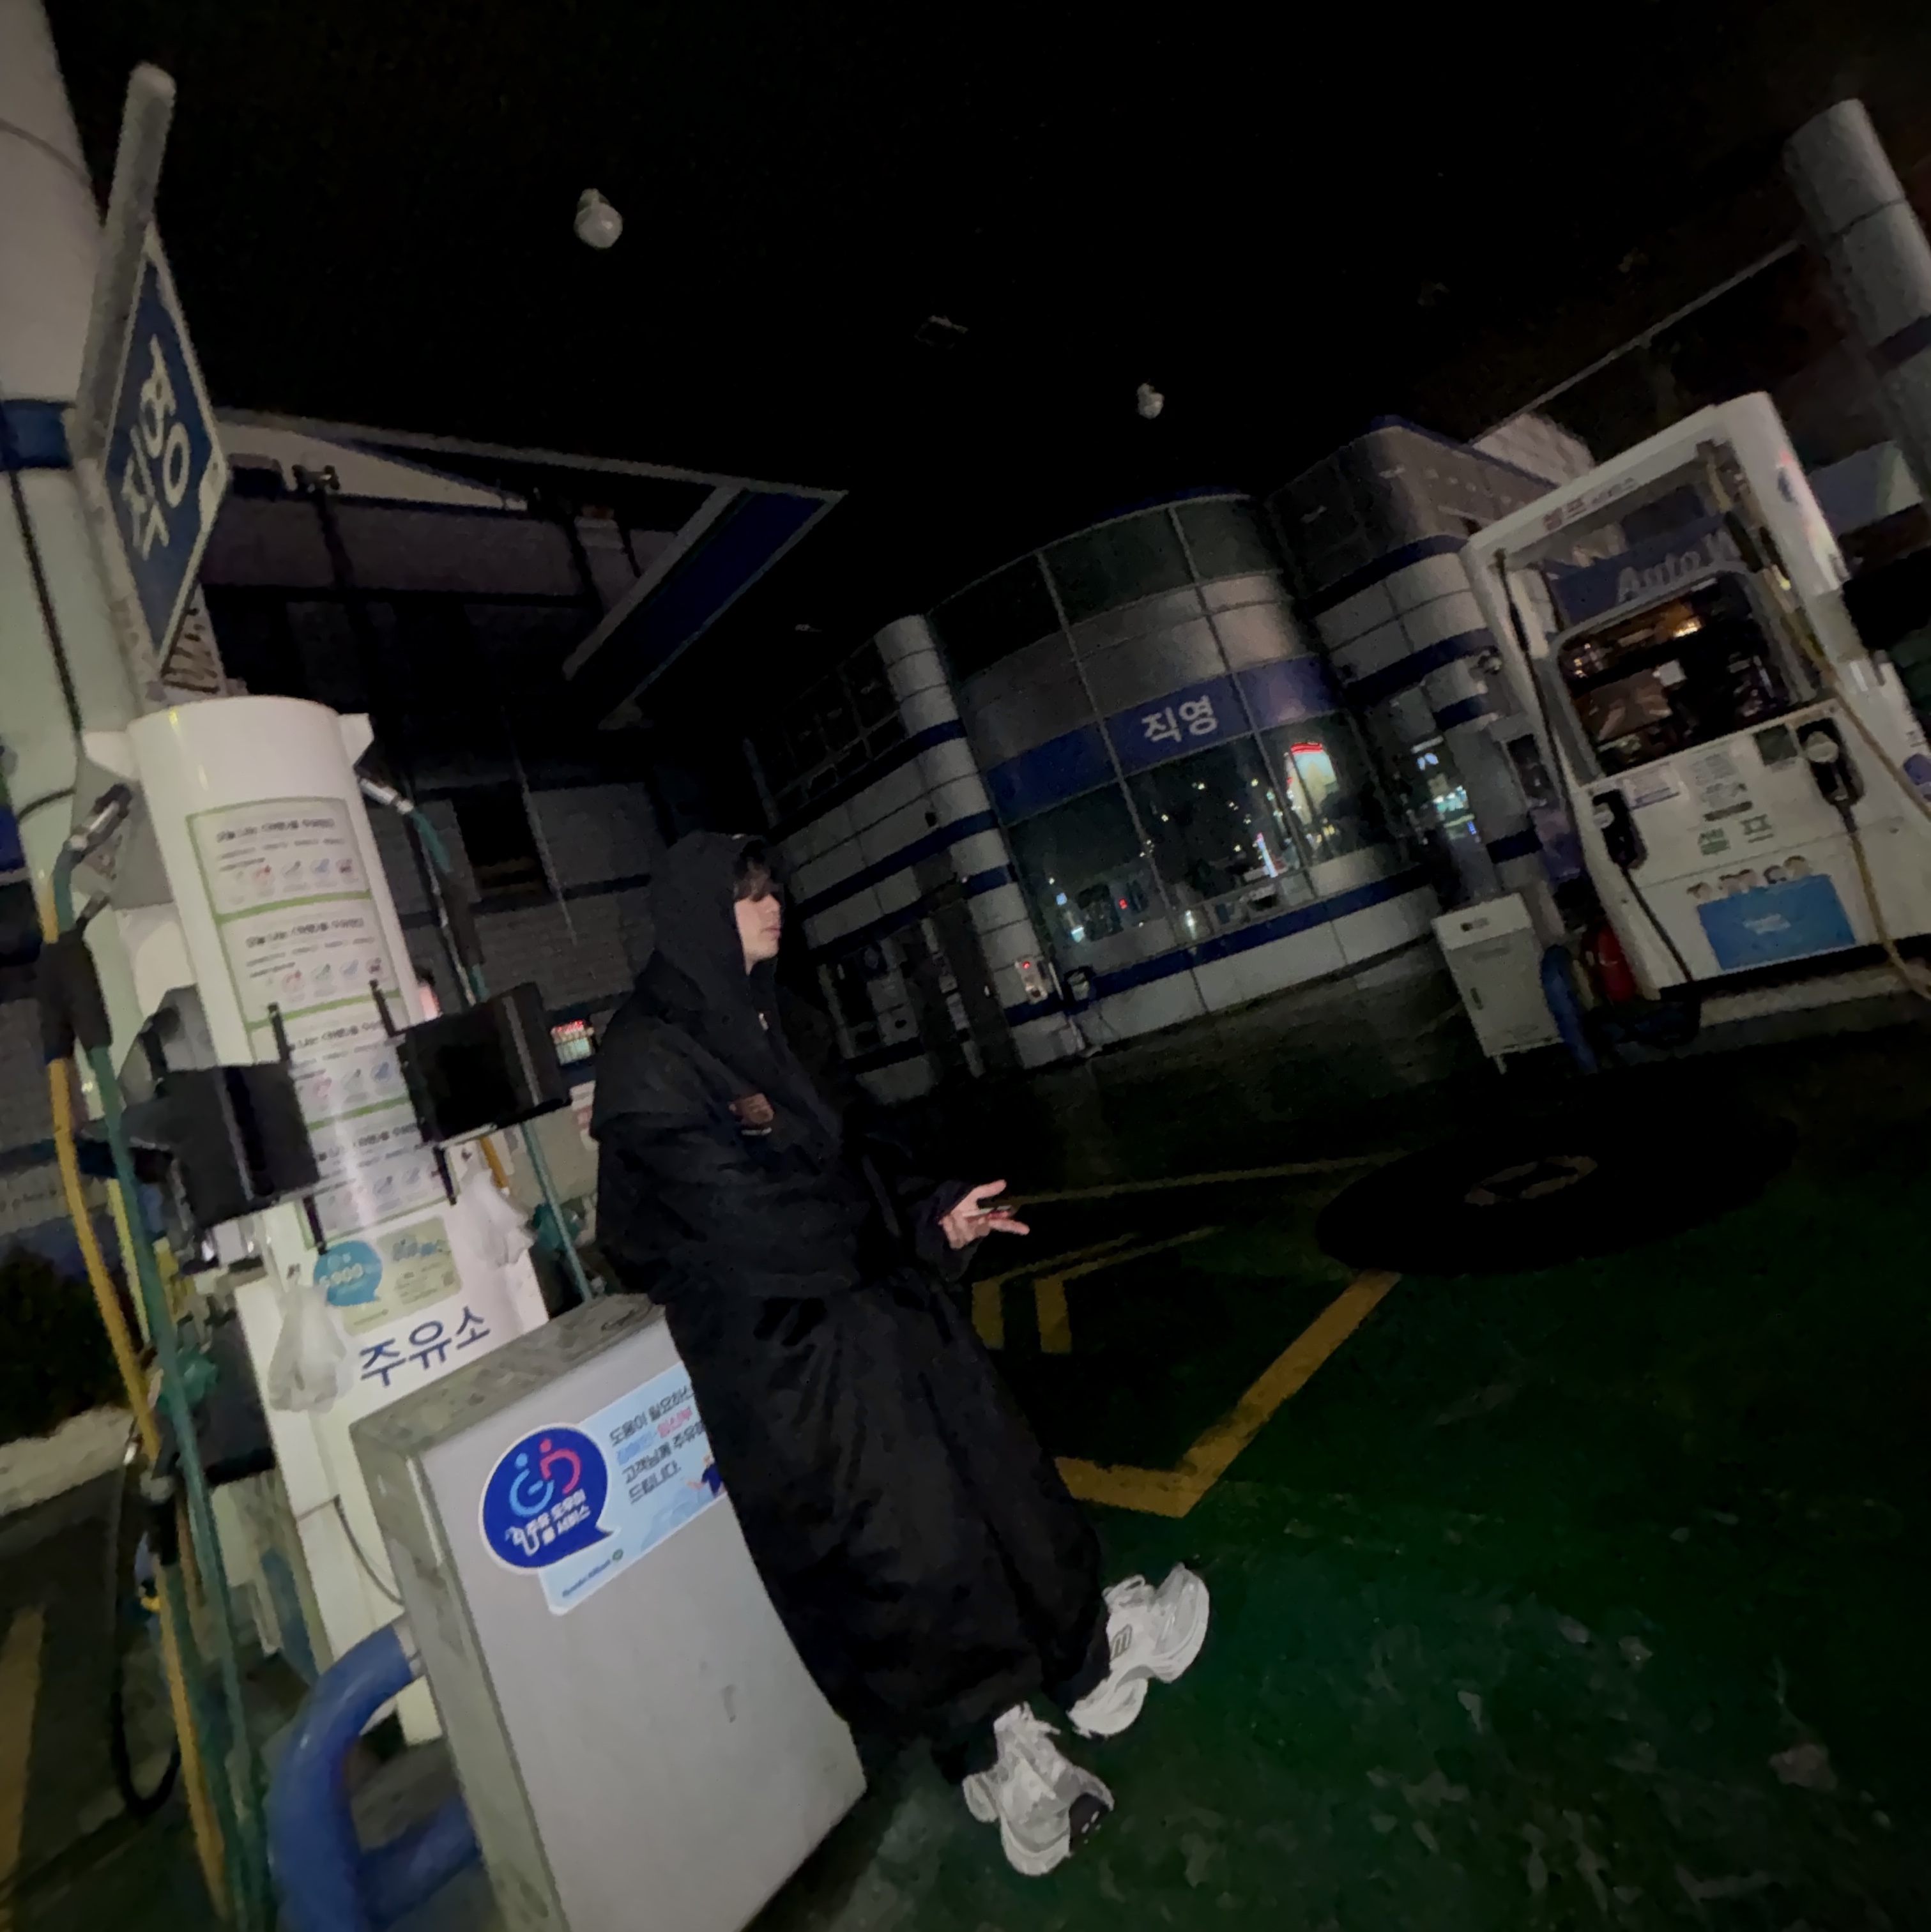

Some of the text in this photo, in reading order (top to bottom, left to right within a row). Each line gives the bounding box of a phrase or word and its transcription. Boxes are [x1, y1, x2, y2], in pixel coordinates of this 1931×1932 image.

[121, 332, 191, 563] 직영
[1141, 694, 1219, 743] 직영
[359, 1305, 491, 1388] 주유소
